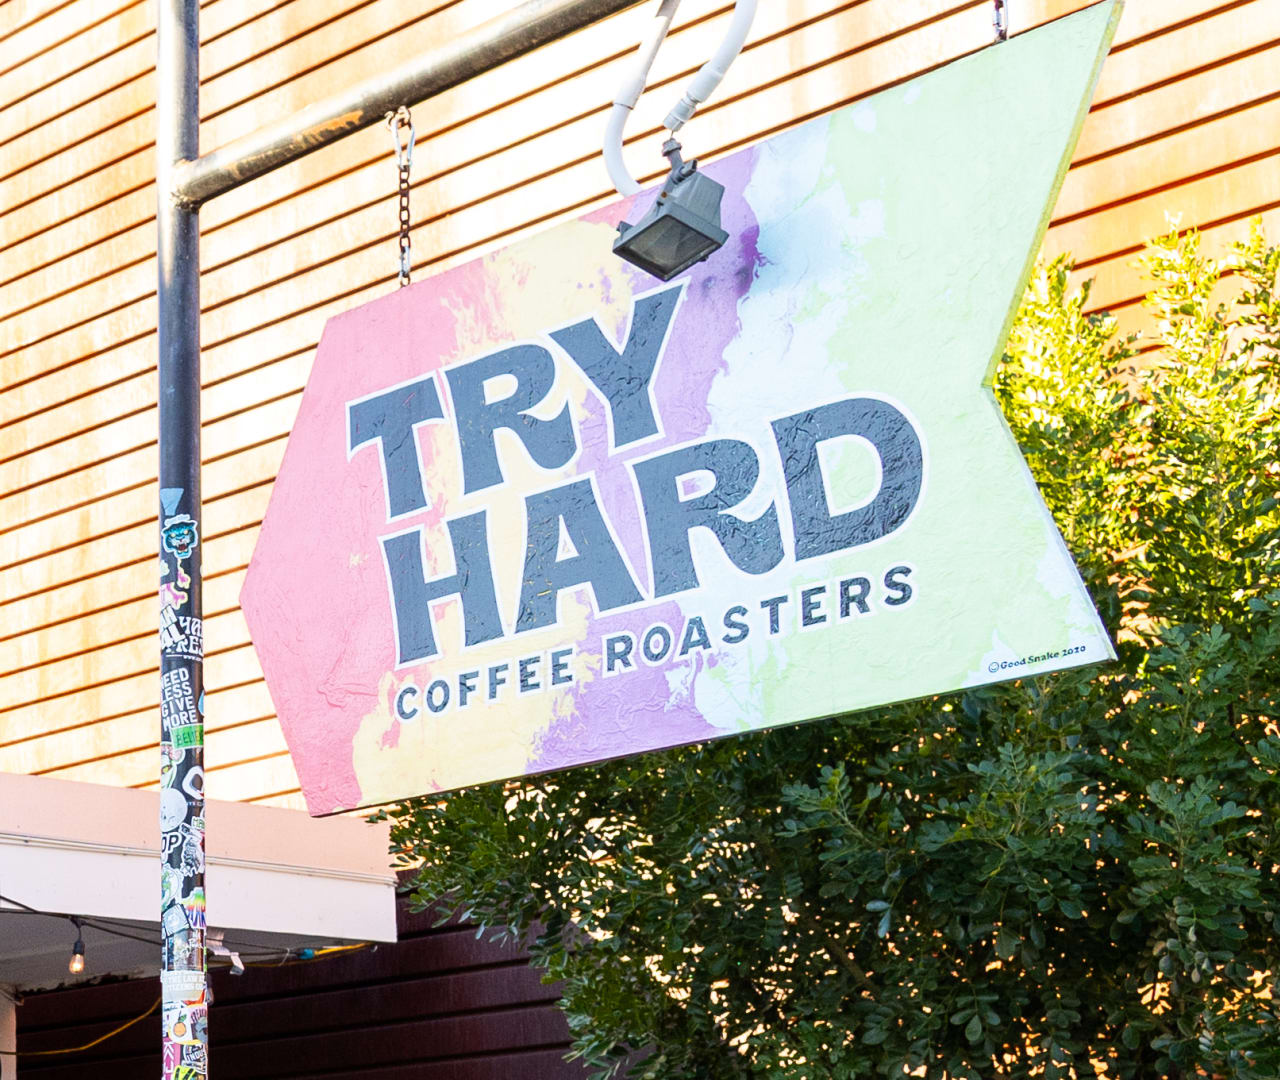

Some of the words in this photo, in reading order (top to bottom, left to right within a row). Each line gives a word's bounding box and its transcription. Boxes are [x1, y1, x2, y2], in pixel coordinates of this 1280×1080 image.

[347, 283, 685, 520] TRY
[383, 397, 924, 665] HARD
[395, 646, 574, 723] COFFEE
[604, 566, 915, 674] ROASTERS
[1000, 658, 1026, 670] Good
[1028, 651, 1060, 665] Snake
[161, 696, 196, 718] GIVE
[163, 710, 198, 732] MORE
